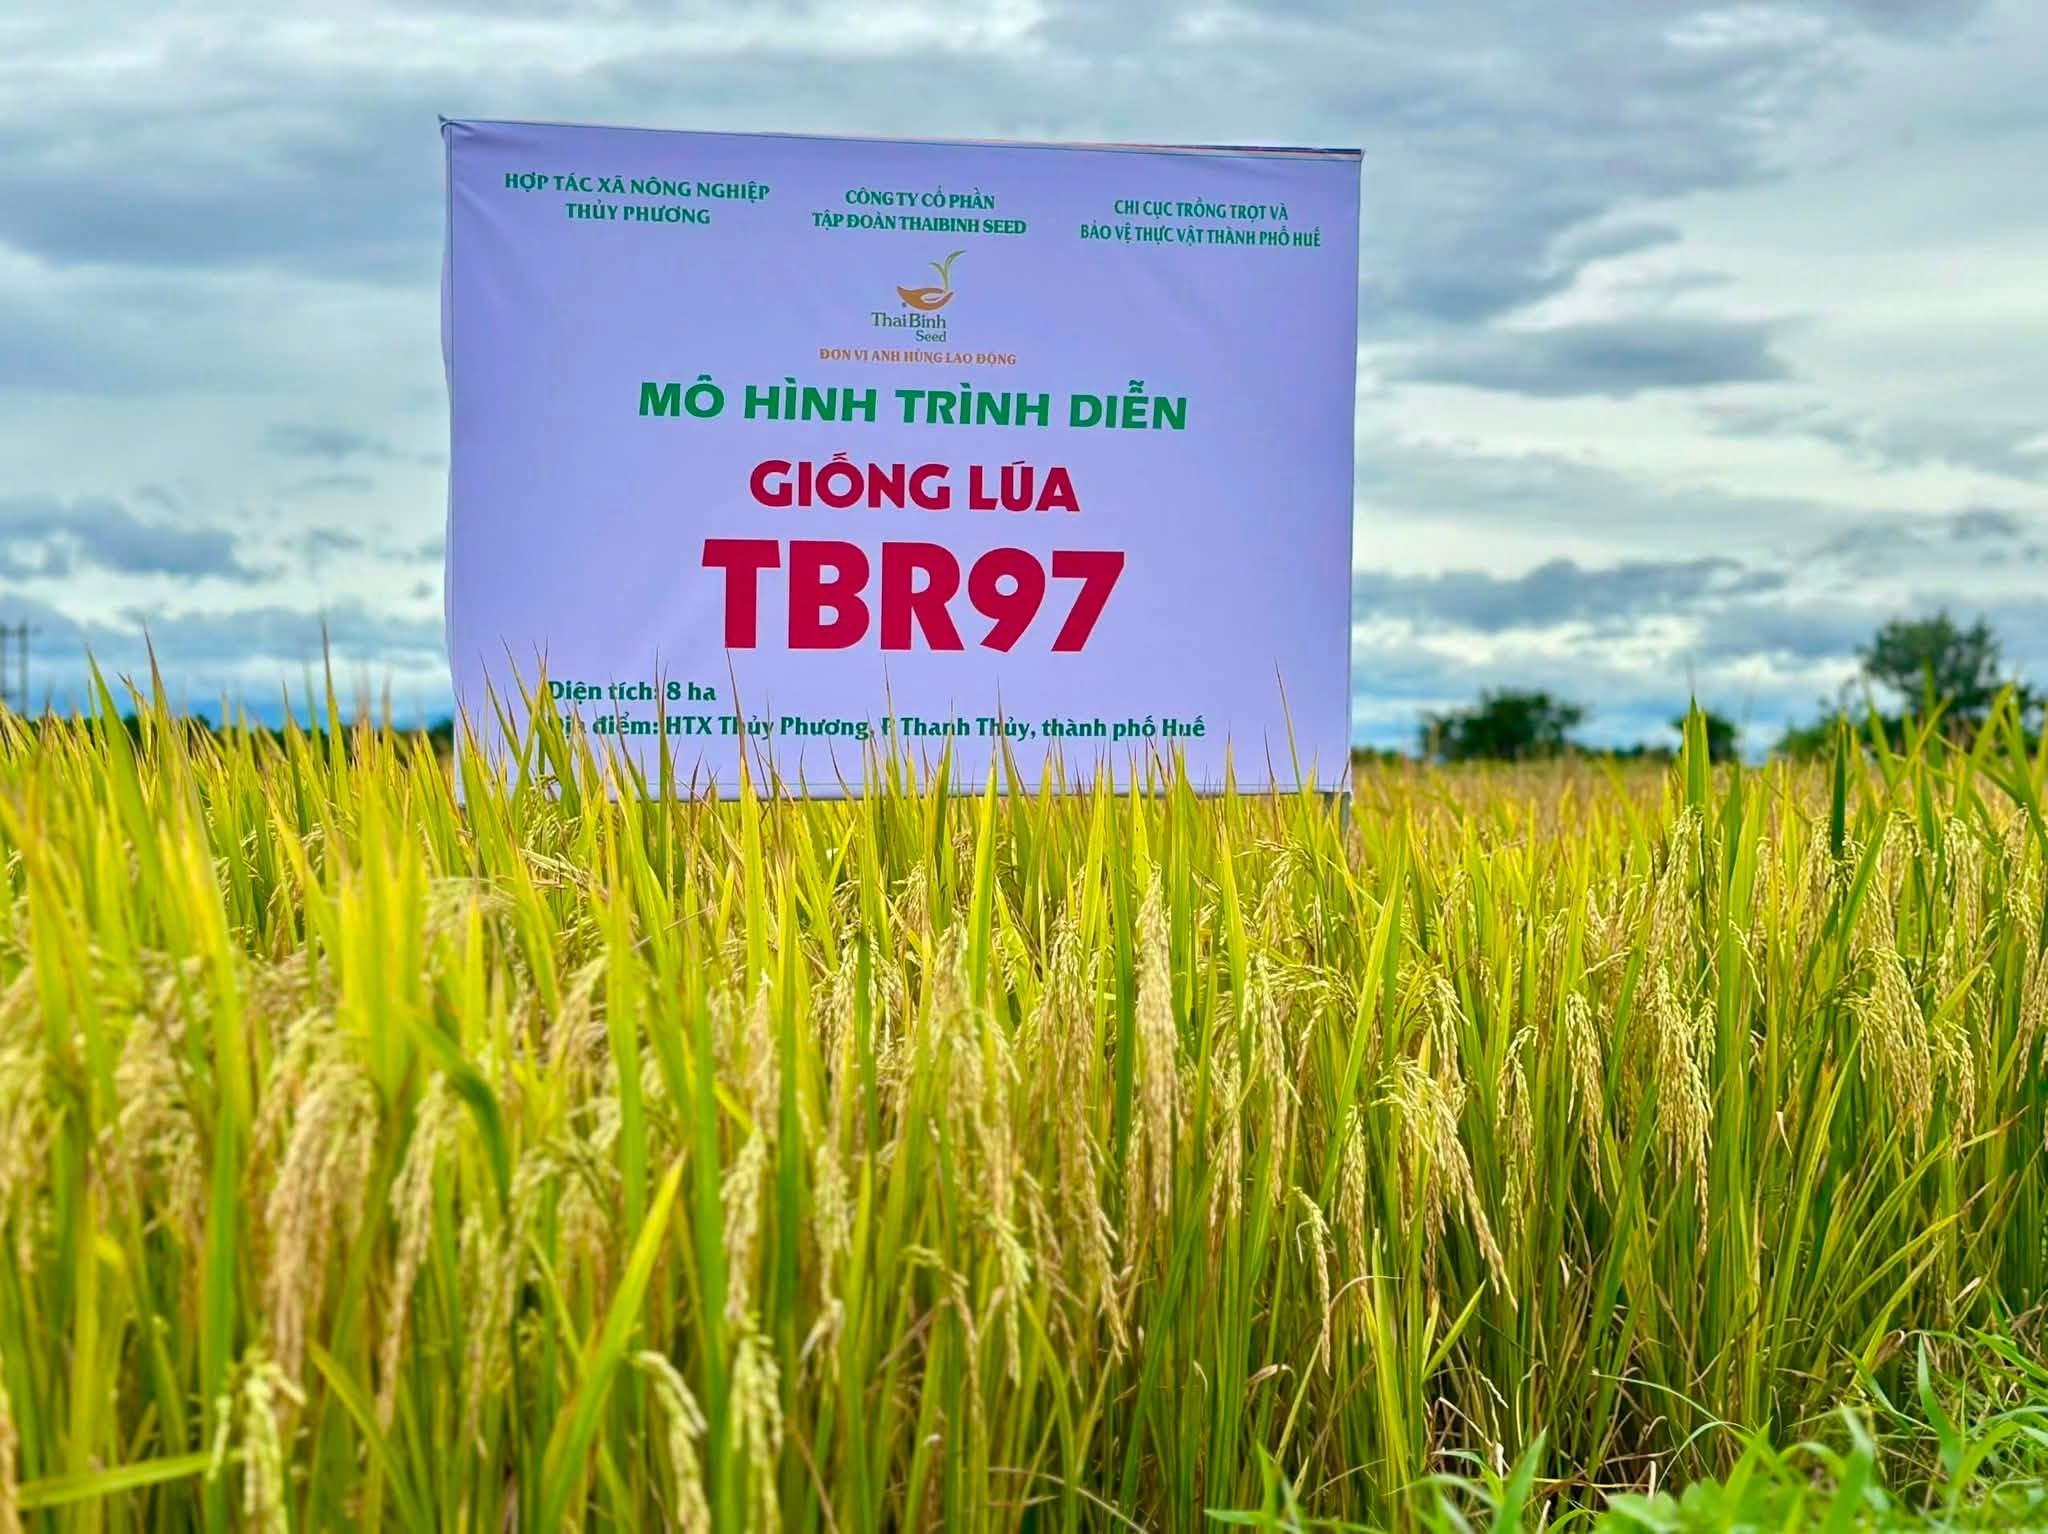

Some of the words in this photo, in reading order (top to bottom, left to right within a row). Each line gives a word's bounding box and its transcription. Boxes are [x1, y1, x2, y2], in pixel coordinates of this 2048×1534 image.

[504, 170, 549, 193] HỢP
[553, 172, 593, 193] TÁC
[597, 174, 626, 195] XÃ
[630, 175, 692, 198] NÔNG
[696, 179, 771, 204] NGHIỆP
[845, 186, 894, 206] CÔNG
[896, 190, 919, 207] TY
[949, 186, 995, 210] PHẦN
[565, 199, 618, 221] THỦY
[623, 204, 711, 225] PHƯƠNG
[812, 209, 844, 231] TẬP
[847, 211, 896, 230] ĐOÀN
[898, 214, 980, 234] THAIBINH
[982, 218, 1027, 235] SEED
[1114, 199, 1140, 216] CHI
[1143, 200, 1173, 220] CỤC
[1176, 196, 1227, 219] TRỒNG
[1230, 202, 1267, 223] TRỌT
[1270, 202, 1289, 221] VÀ
[1115, 221, 1132, 244] VỆ
[1135, 225, 1175, 246] THỰC
[1177, 224, 1204, 247] VẬT
[1207, 226, 1256, 246] THÀNH
[1293, 226, 1321, 247] HUẾ
[915, 329, 947, 343] Seed
[871, 350, 900, 363] ANH
[946, 352, 973, 366] LAO
[637, 374, 725, 419] MÔ
[742, 376, 878, 424] HÌNH
[894, 380, 1050, 428] TRÌNH
[1068, 378, 1188, 432] DIỄN
[748, 450, 952, 512] GIỐNG
[967, 459, 1082, 514] LÚA
[700, 537, 1126, 654] TBR97
[548, 680, 602, 705] Diện
[666, 681, 681, 701] 8
[688, 681, 717, 701] ha
[666, 716, 712, 735] HTX
[718, 715, 774, 741] Thủy
[900, 717, 970, 736] Thanh
[975, 716, 1036, 742] Thủy,
[1041, 718, 1107, 737] thành
[1112, 715, 1157, 741] phố
[1162, 715, 1206, 737] Huế
